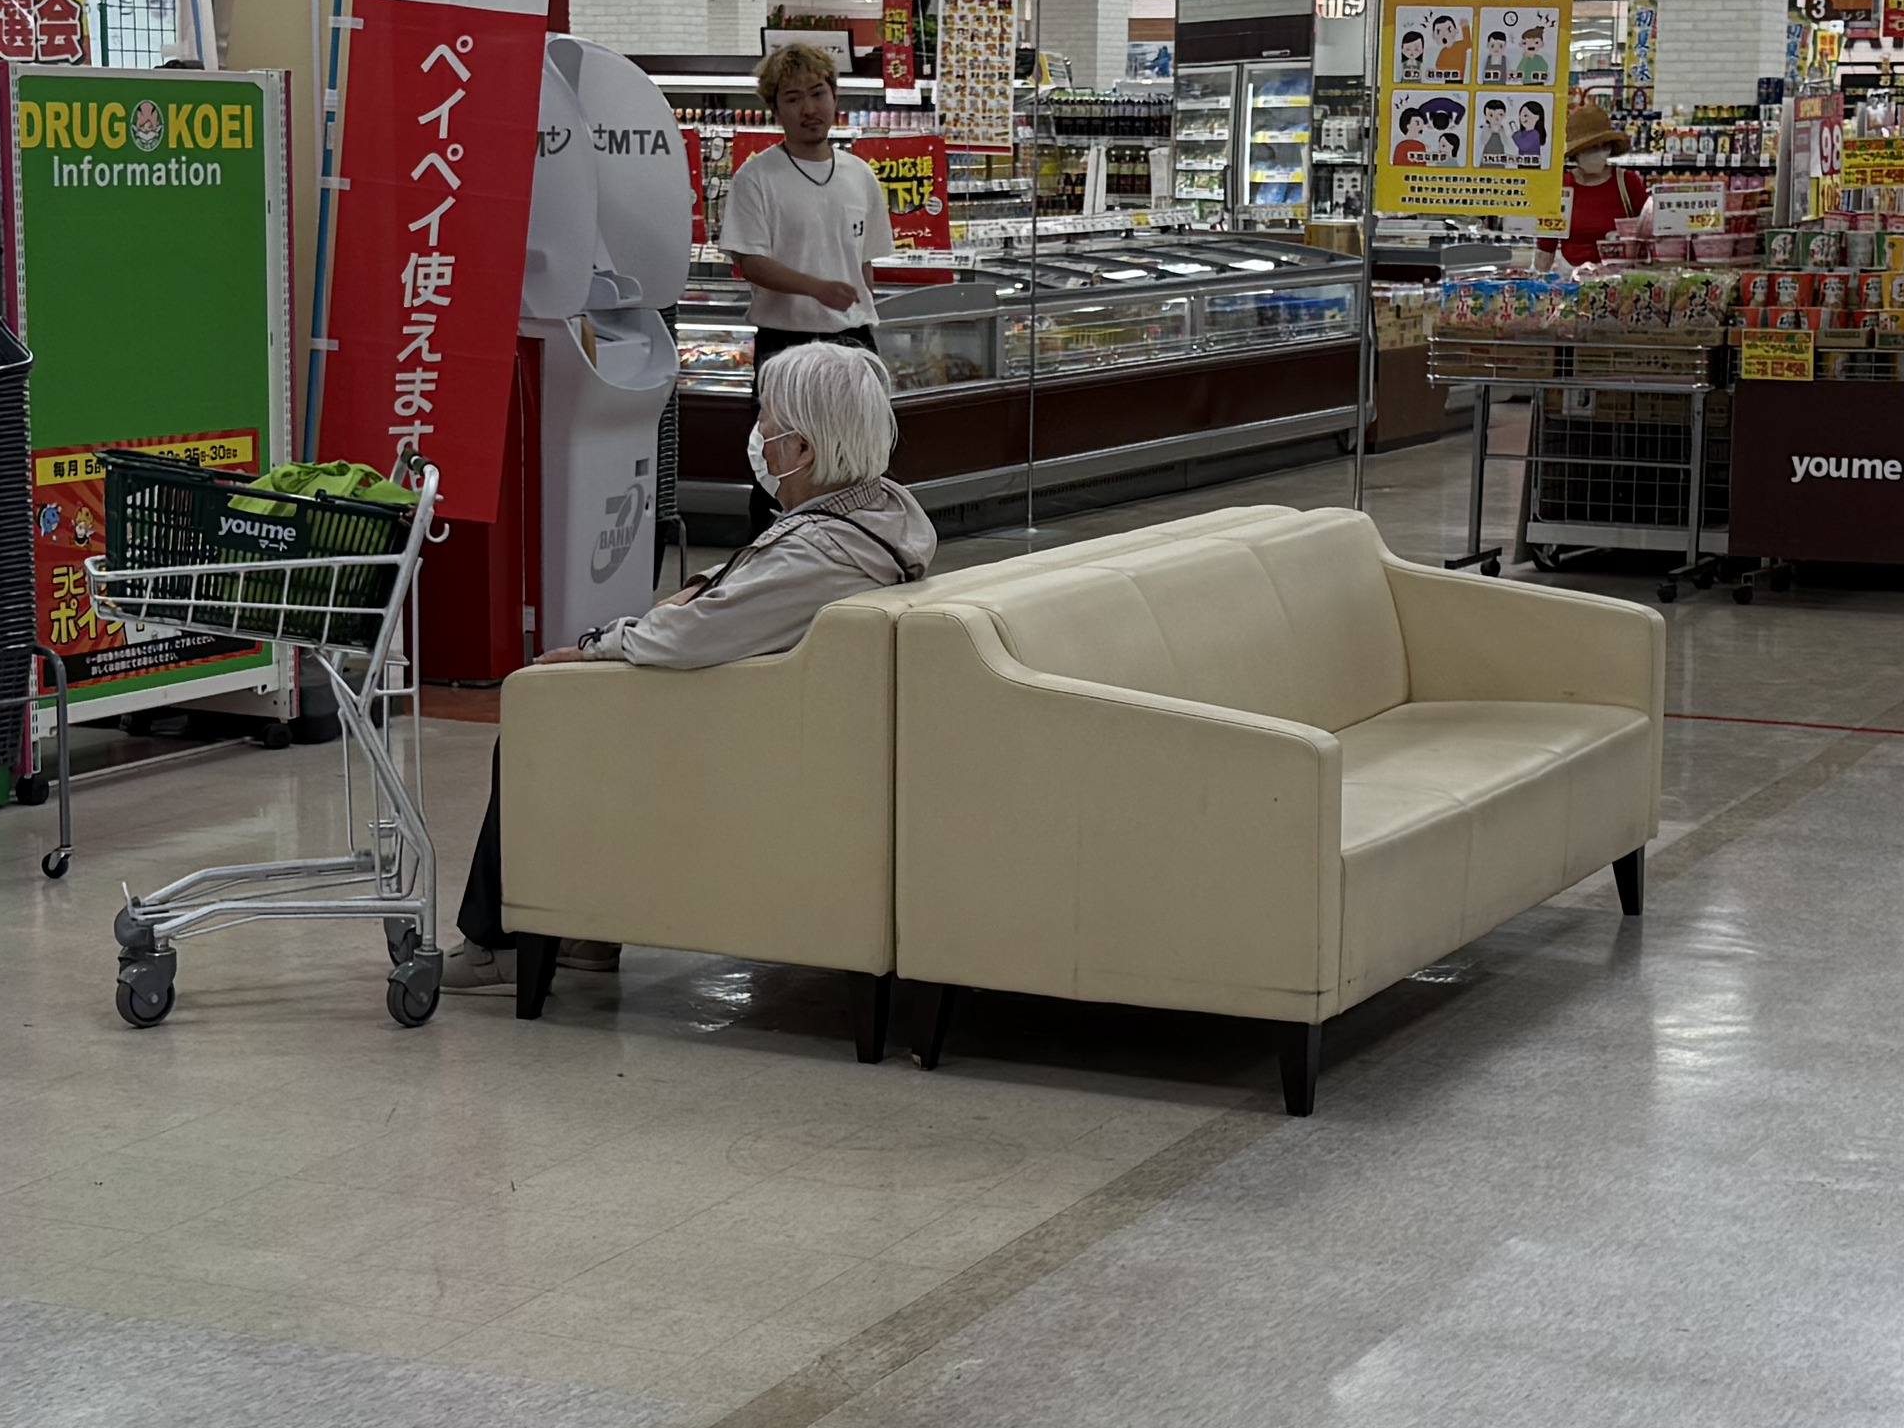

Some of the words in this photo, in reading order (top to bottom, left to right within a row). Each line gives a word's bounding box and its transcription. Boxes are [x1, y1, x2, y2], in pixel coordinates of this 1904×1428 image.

[17, 101, 127, 150] DRUG
[167, 103, 254, 150] KOEI
[52, 156, 222, 189] Information
[53, 459, 78, 479] 毎月
[1790, 454, 1903, 483] youme
[218, 515, 297, 542] youme
[259, 539, 288, 552] マート
